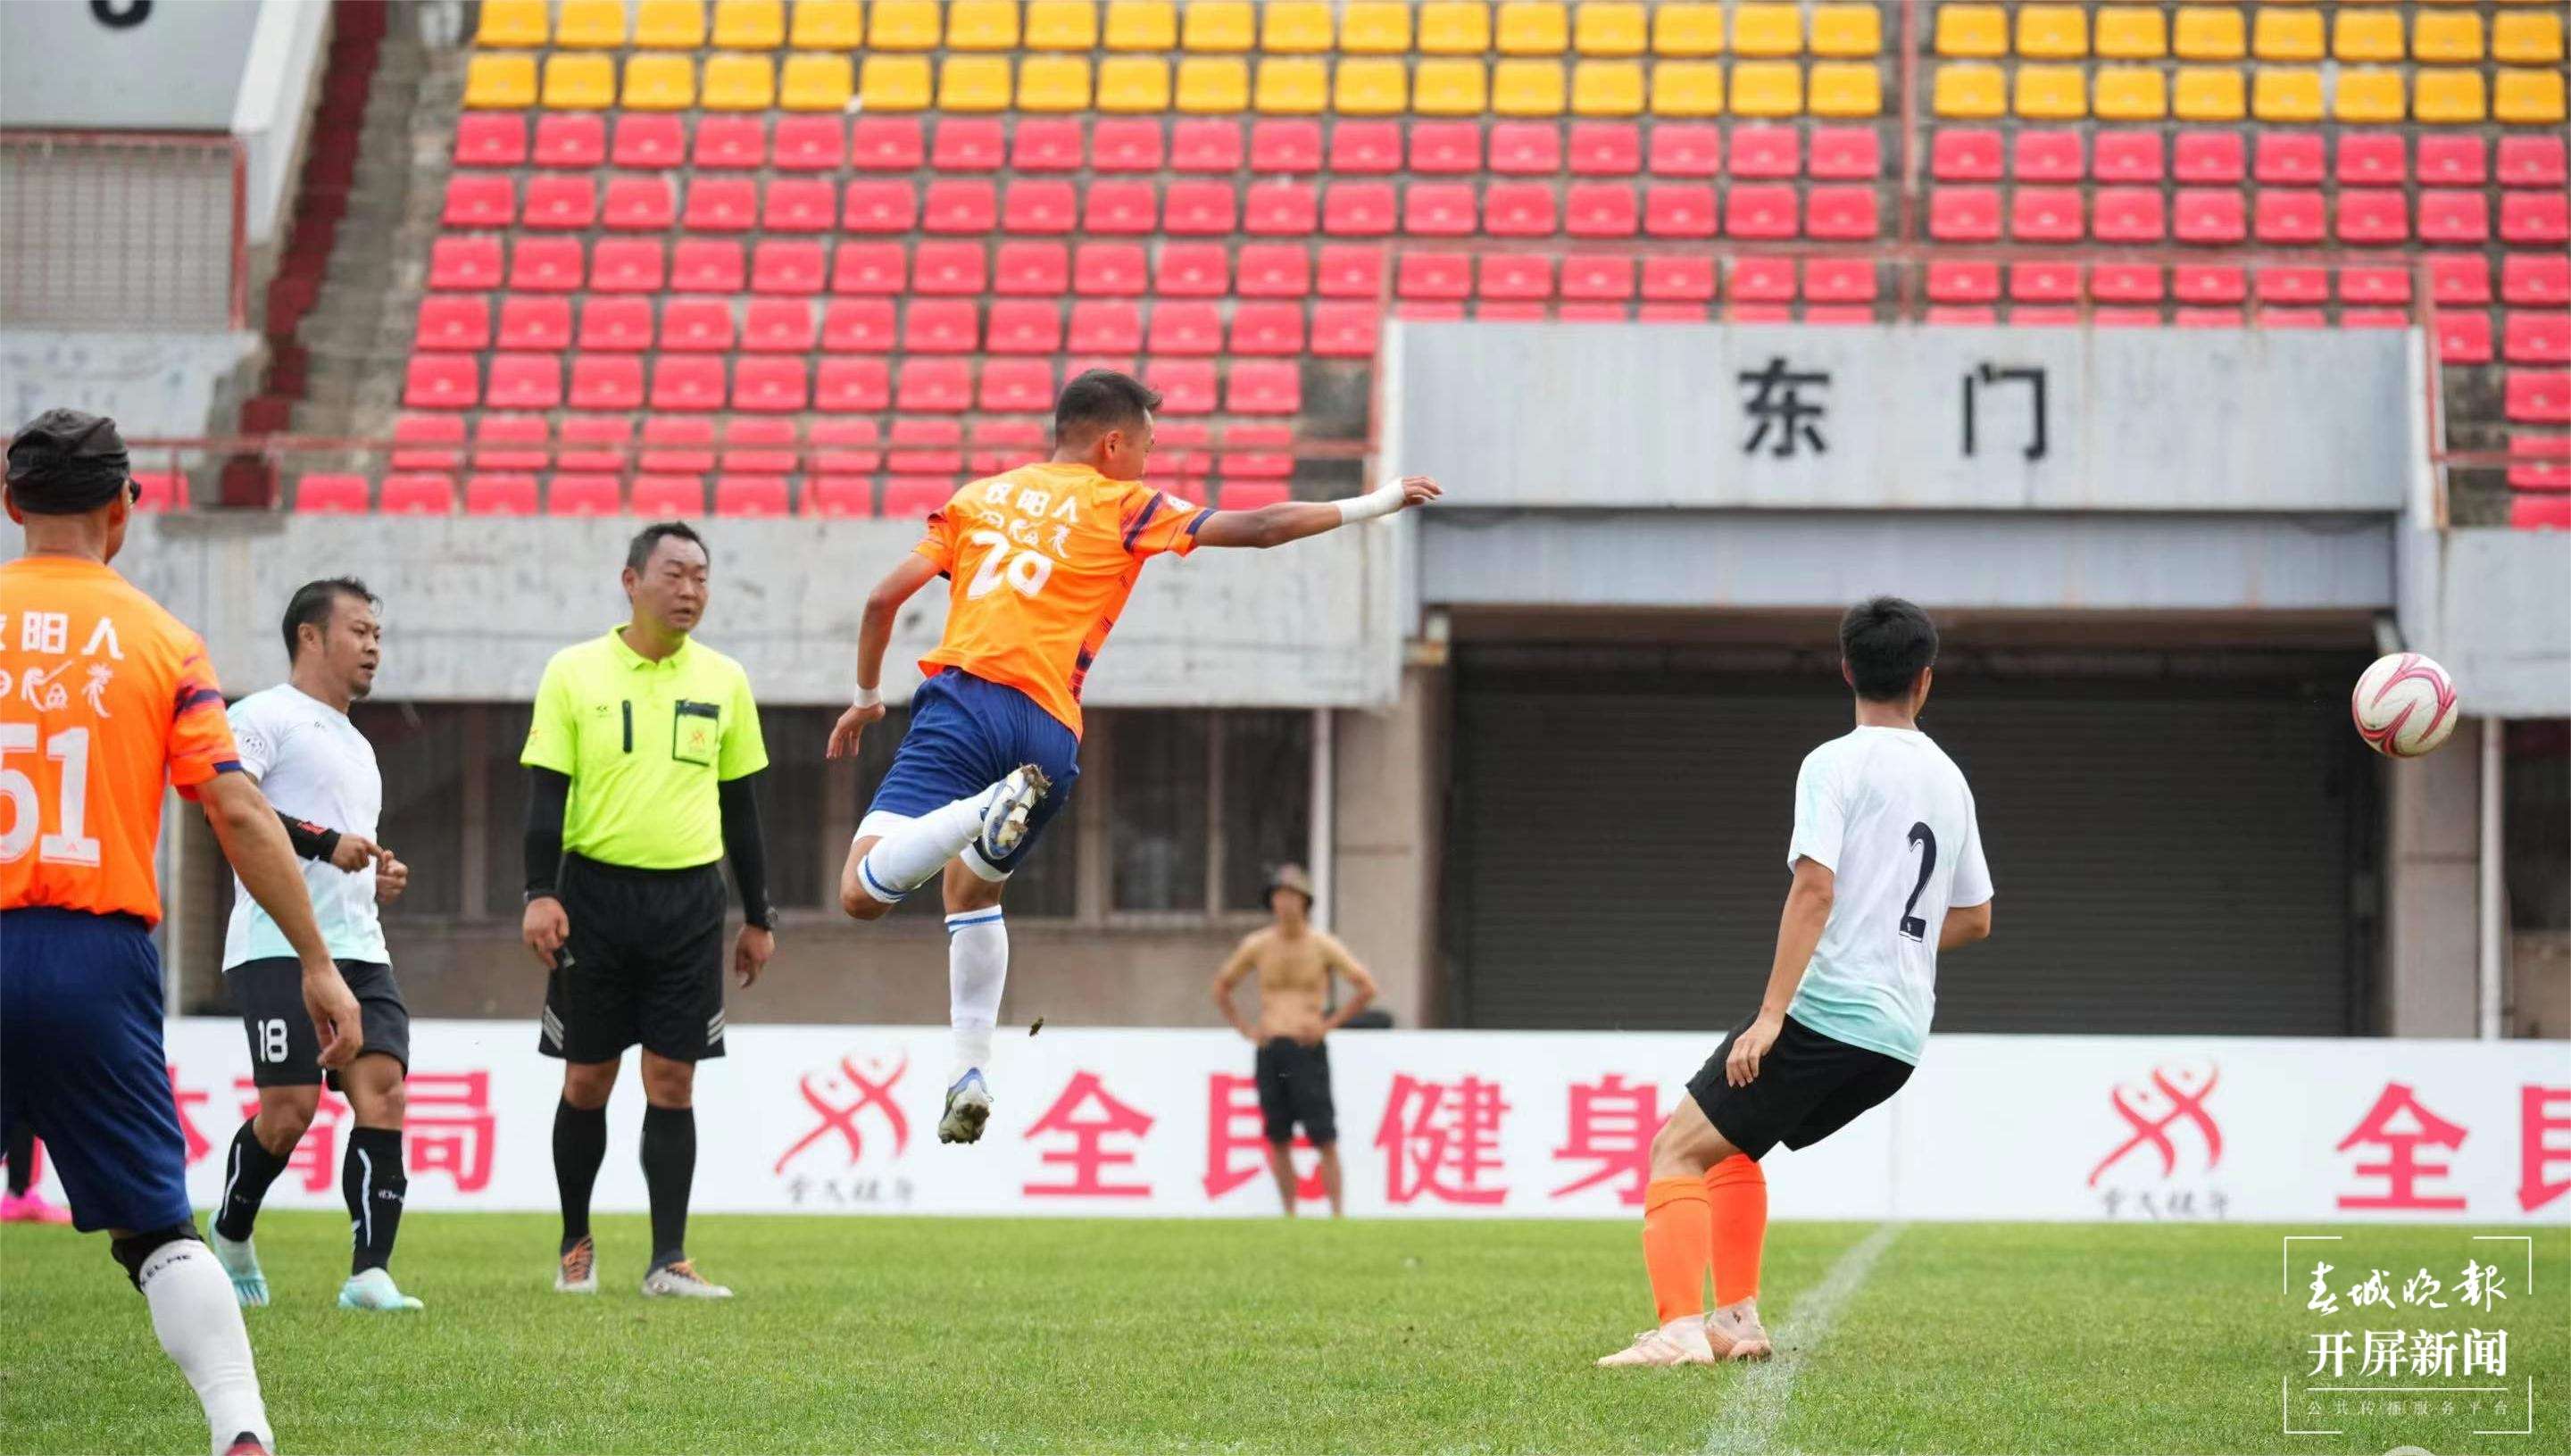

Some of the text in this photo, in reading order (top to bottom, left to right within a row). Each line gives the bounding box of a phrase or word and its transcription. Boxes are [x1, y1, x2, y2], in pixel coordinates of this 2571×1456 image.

[1737, 359, 2050, 461] 东门
[0, 611, 125, 661] 阳人
[0, 723, 101, 868] 51
[1899, 820, 1938, 944] 2
[257, 1018, 288, 1063] 18
